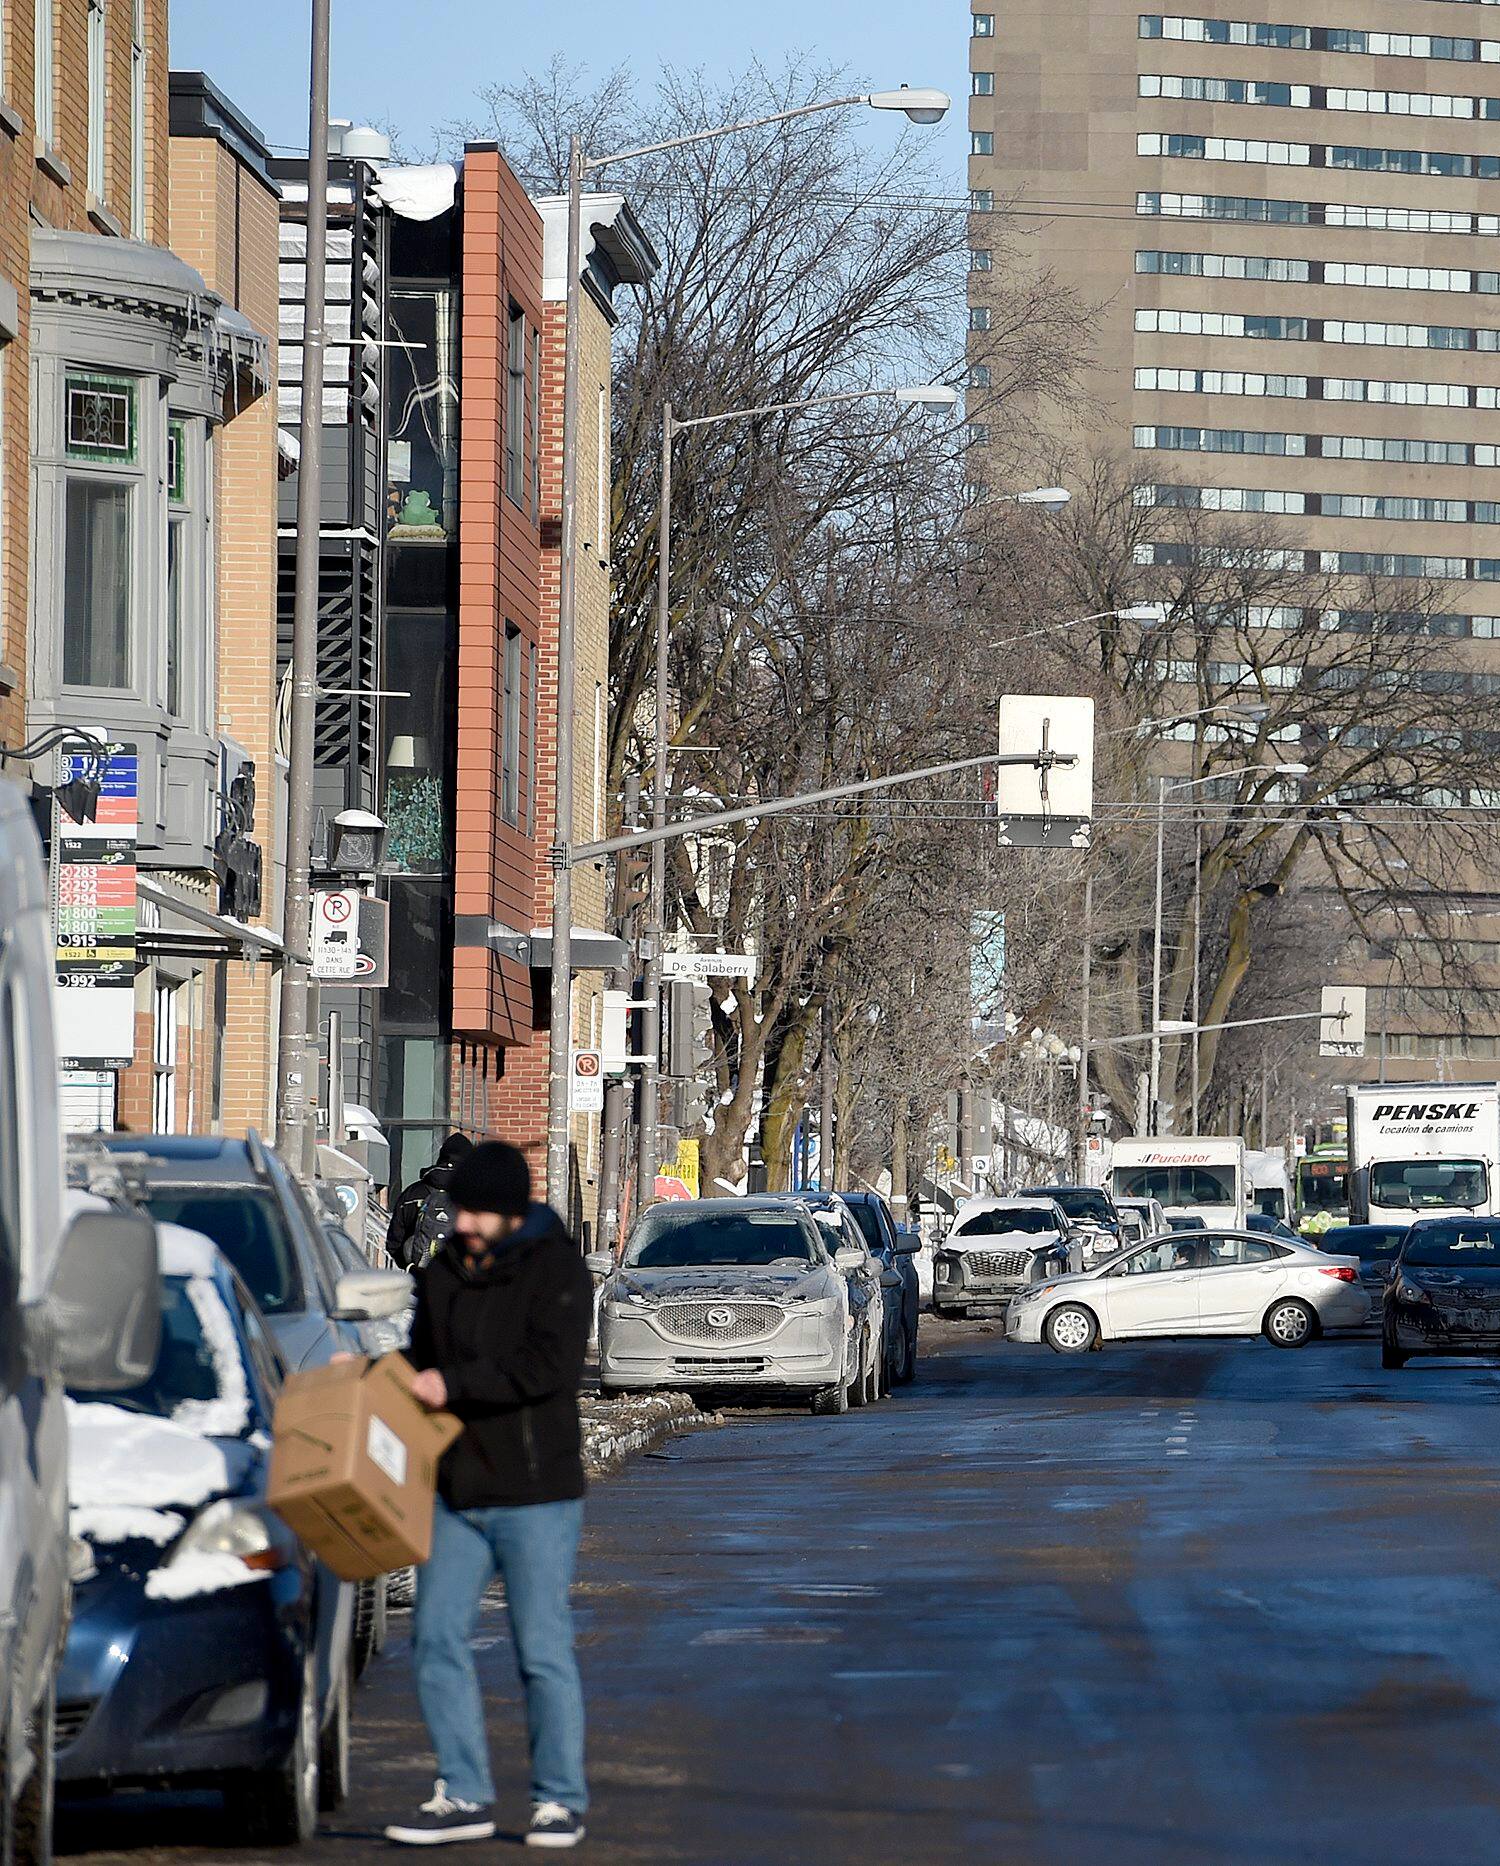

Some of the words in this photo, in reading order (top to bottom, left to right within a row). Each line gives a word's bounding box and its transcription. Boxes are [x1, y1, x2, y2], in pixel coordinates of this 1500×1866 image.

[72, 866, 97, 878] 283
[72, 880, 97, 892] 292
[72, 894, 97, 906] 294
[72, 907, 97, 919] 800
[72, 921, 96, 933] 801
[71, 935, 97, 947] 915
[672, 962, 687, 971] De
[693, 963, 749, 975] Salaberry
[70, 975, 96, 987] 992
[1371, 1103, 1483, 1121] PENSKE
[1379, 1124, 1420, 1134] Location
[1421, 1124, 1434, 1134] de
[1435, 1124, 1474, 1134] camions
[1151, 1154, 1211, 1164] Purolator
